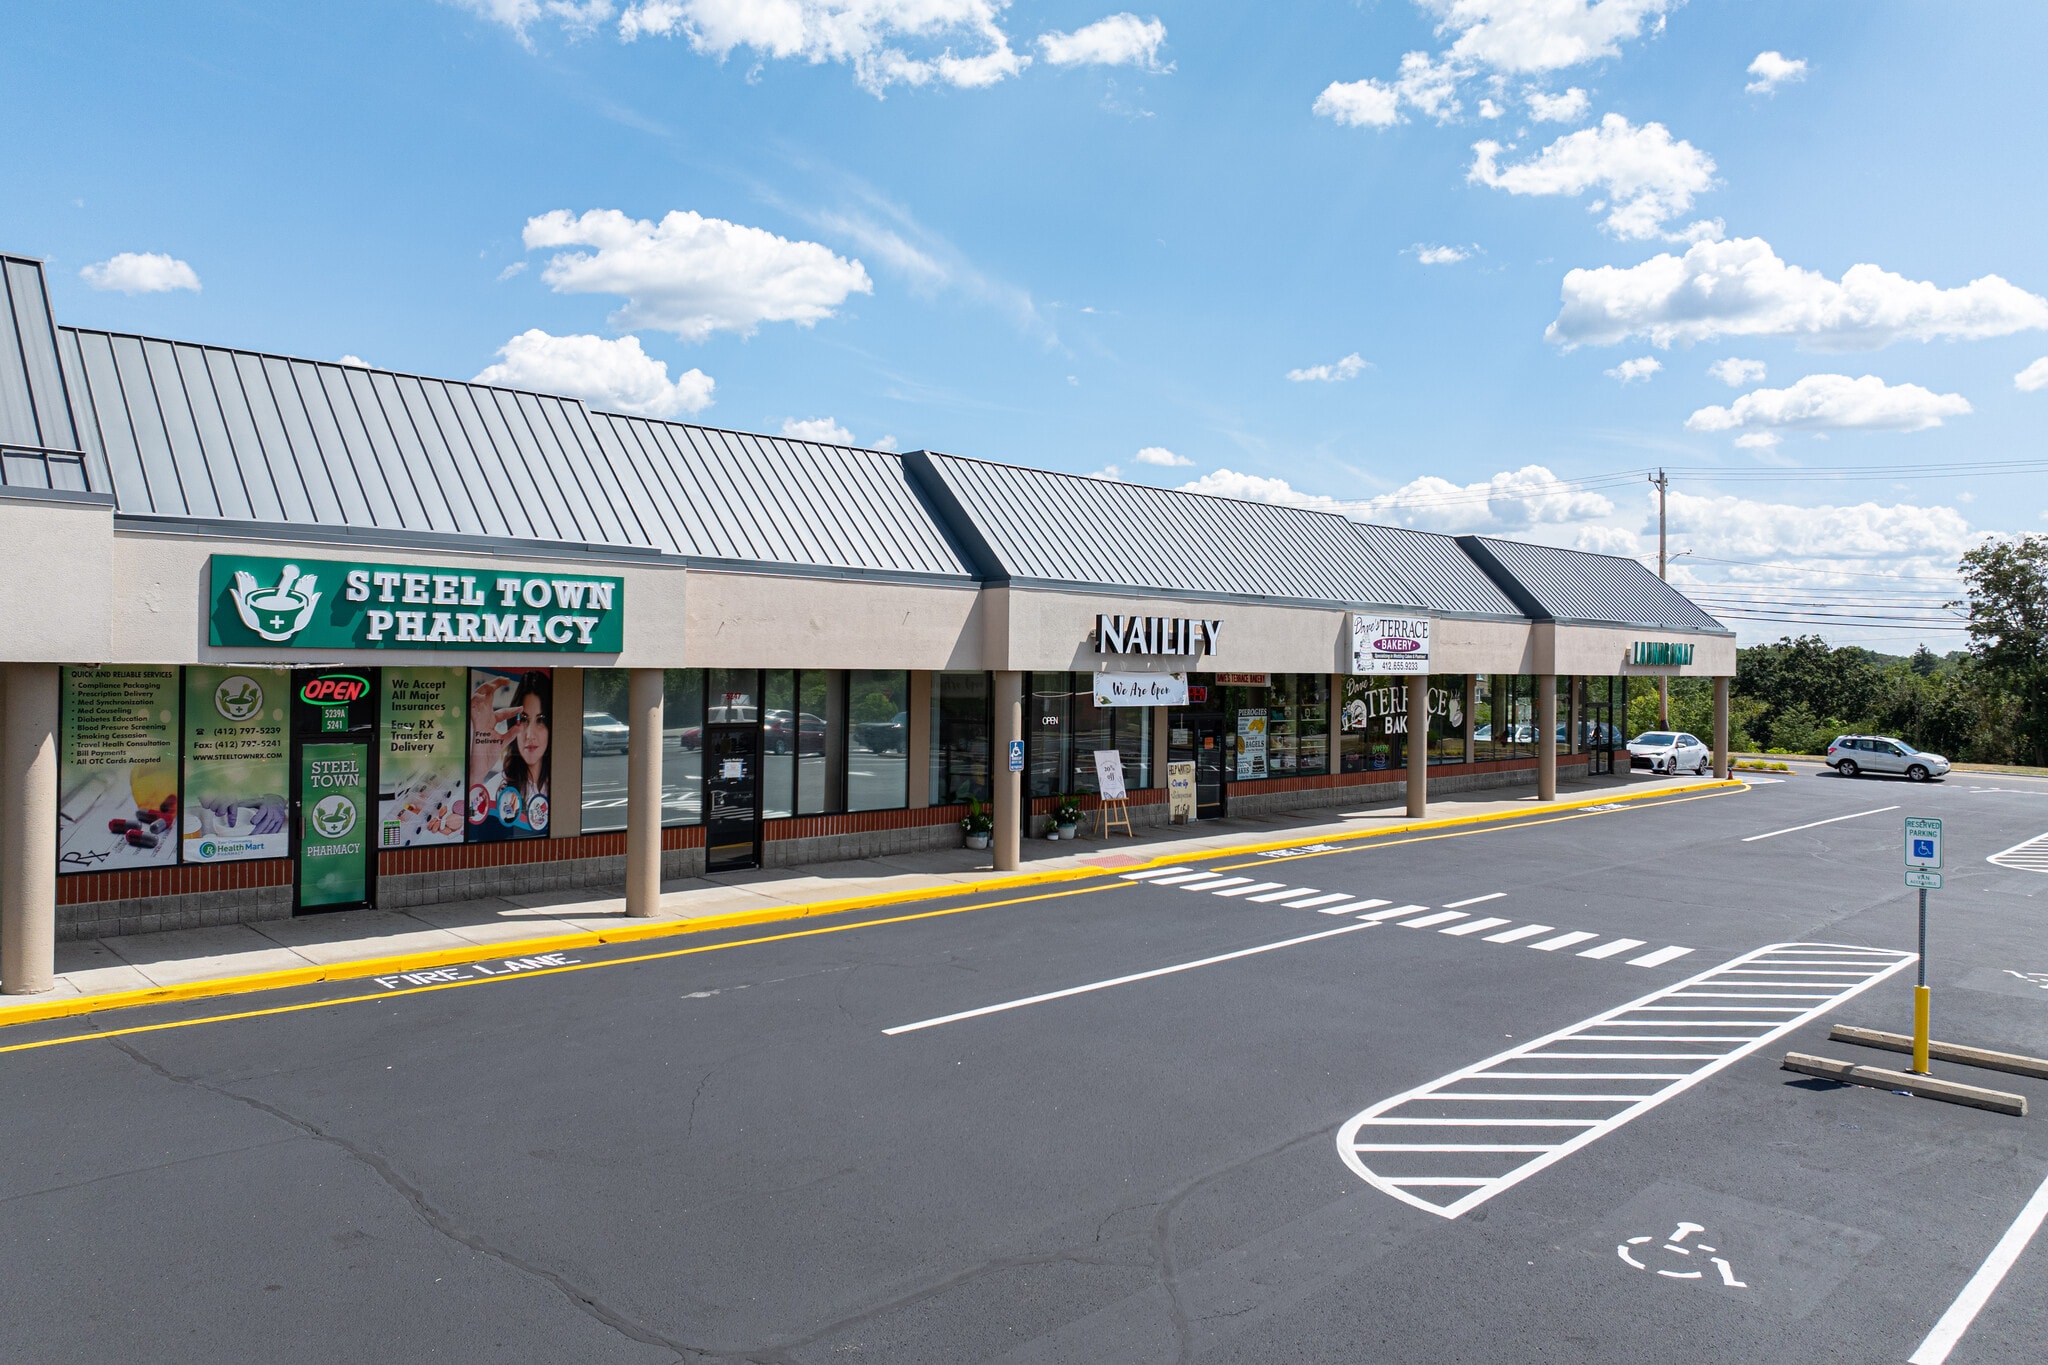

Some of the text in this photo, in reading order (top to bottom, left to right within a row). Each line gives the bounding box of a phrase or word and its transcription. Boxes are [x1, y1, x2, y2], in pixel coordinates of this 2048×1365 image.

[346, 570, 616, 610] STEEL TOWN
[366, 610, 599, 644] PHARMACY
[1354, 616, 1428, 638] Dave's TERRACE
[1097, 614, 1224, 656] NAILIFY
[1382, 640, 1412, 650] BAKERY
[1631, 640, 1694, 666] LAUNDROMAT
[305, 680, 362, 700] OPEN
[392, 680, 446, 690] We Accept
[1112, 682, 1171, 700] We Are Open
[392, 691, 440, 702] All Major
[1188, 687, 1206, 701] PEN
[392, 702, 446, 710] Insurances
[1365, 686, 1448, 718] TERRCE
[325, 709, 345, 718] 5239A
[327, 721, 342, 729] 5241
[392, 720, 434, 730] Easy RX
[1042, 717, 1058, 725] OPEN
[1385, 716, 1431, 734] BAKY
[391, 731, 445, 740] Transfer &
[391, 742, 434, 753] Delivery
[311, 760, 359, 774] STEEL
[311, 774, 359, 788] TOWN
[1906, 821, 1940, 829] RESERVED
[1910, 829, 1937, 837] PARKING
[218, 844, 244, 852] Health
[307, 844, 360, 856] PHARMACY
[374, 952, 581, 989] FIRE LANE
